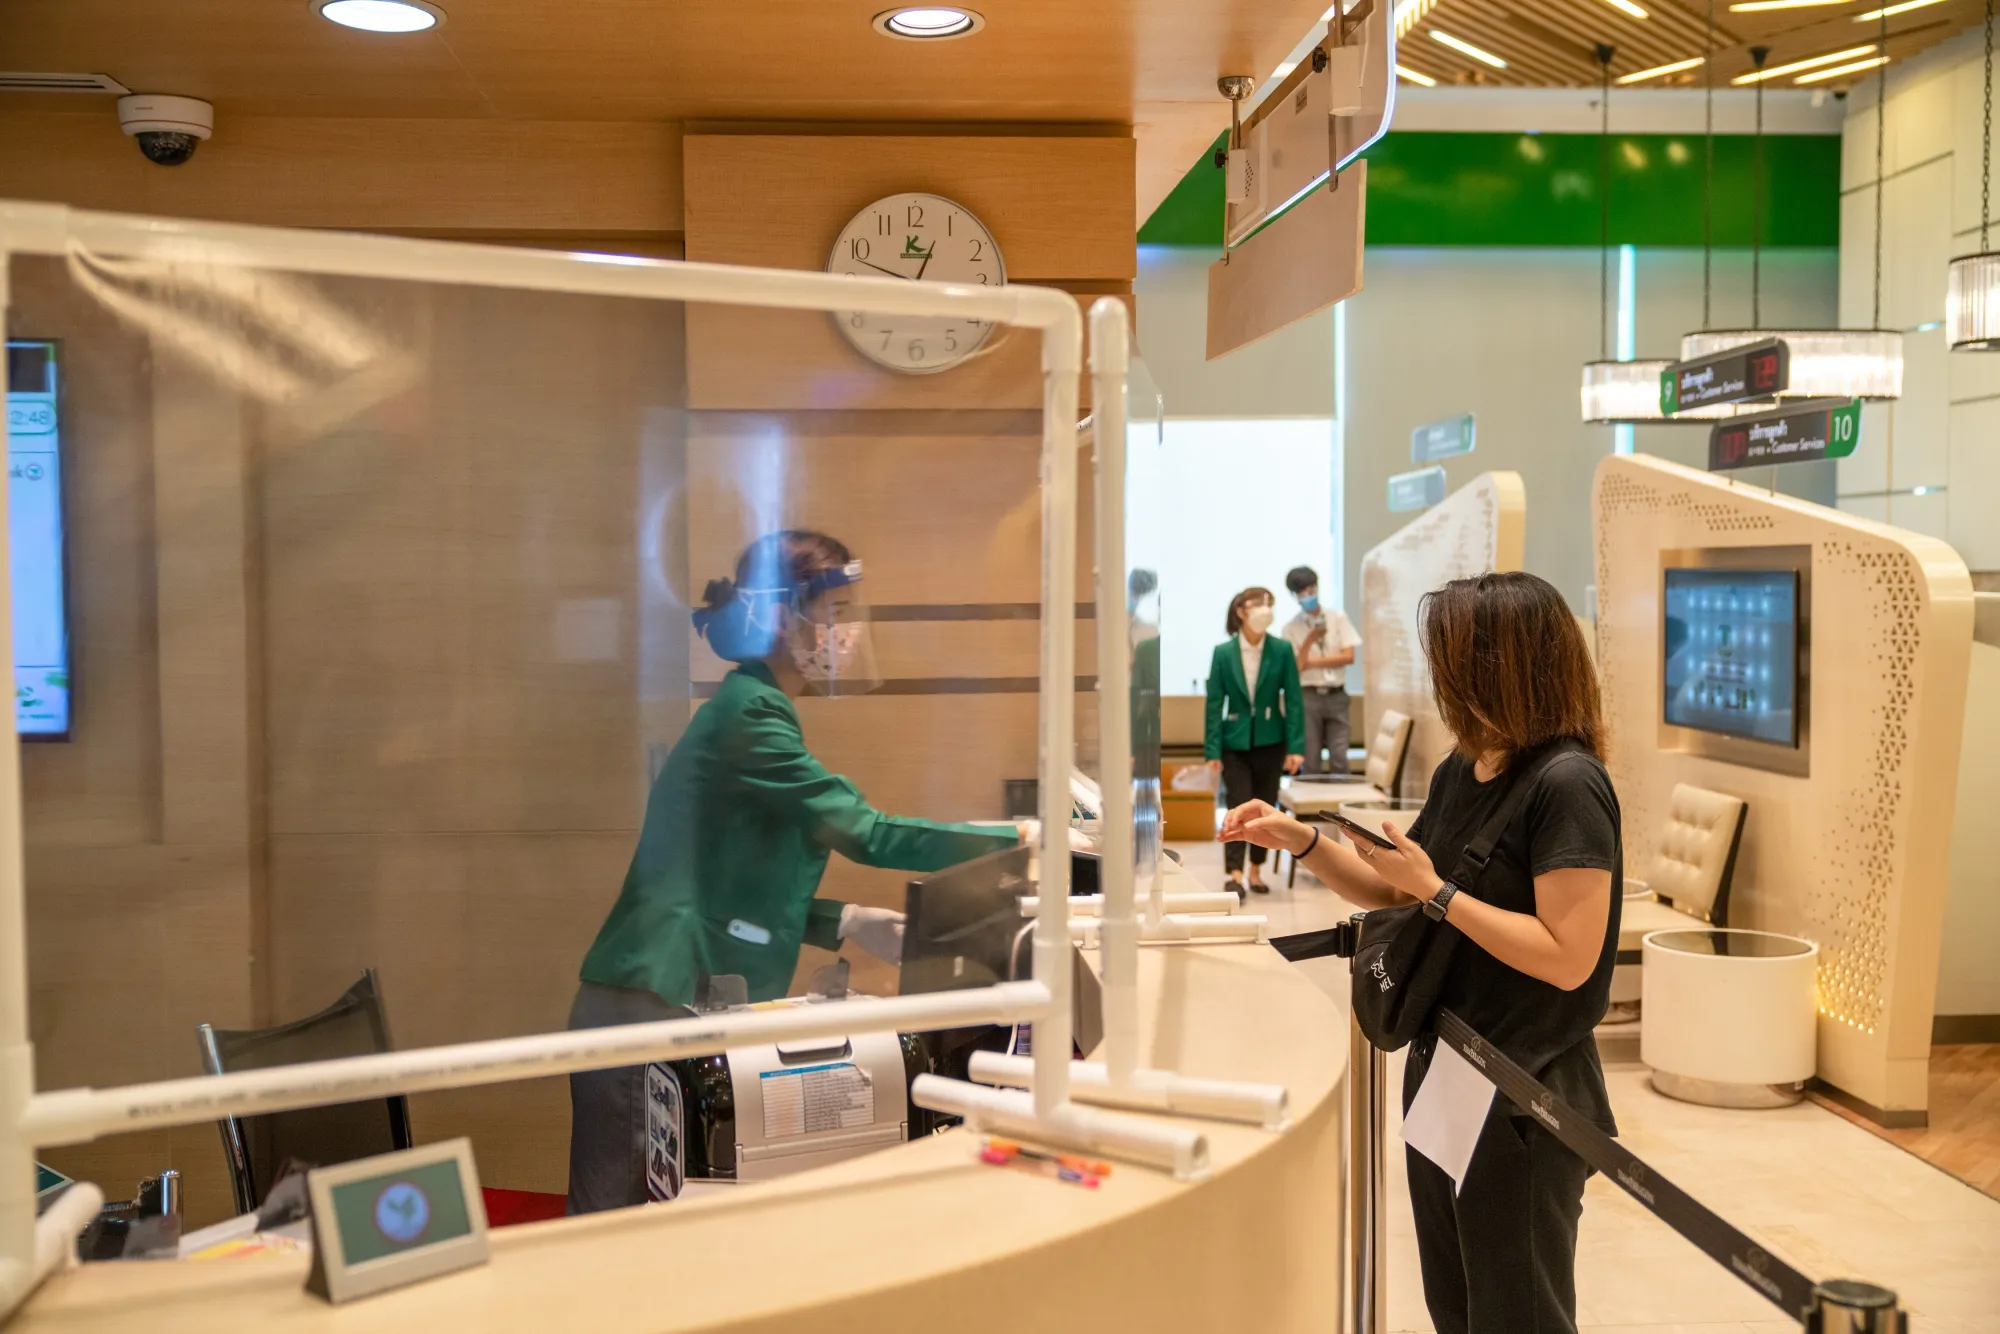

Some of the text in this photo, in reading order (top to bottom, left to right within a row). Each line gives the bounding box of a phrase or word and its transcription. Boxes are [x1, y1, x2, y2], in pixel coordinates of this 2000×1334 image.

[879, 215, 891, 236] 11
[907, 206, 925, 228] 12
[851, 238, 870, 260] 10
[905, 235, 927, 254] K
[969, 239, 982, 262] 2
[879, 330, 893, 351] 7
[908, 339, 925, 362] 6
[945, 329, 957, 352] 5
[1664, 380, 1673, 402] 9
[1834, 414, 1853, 442] 10
